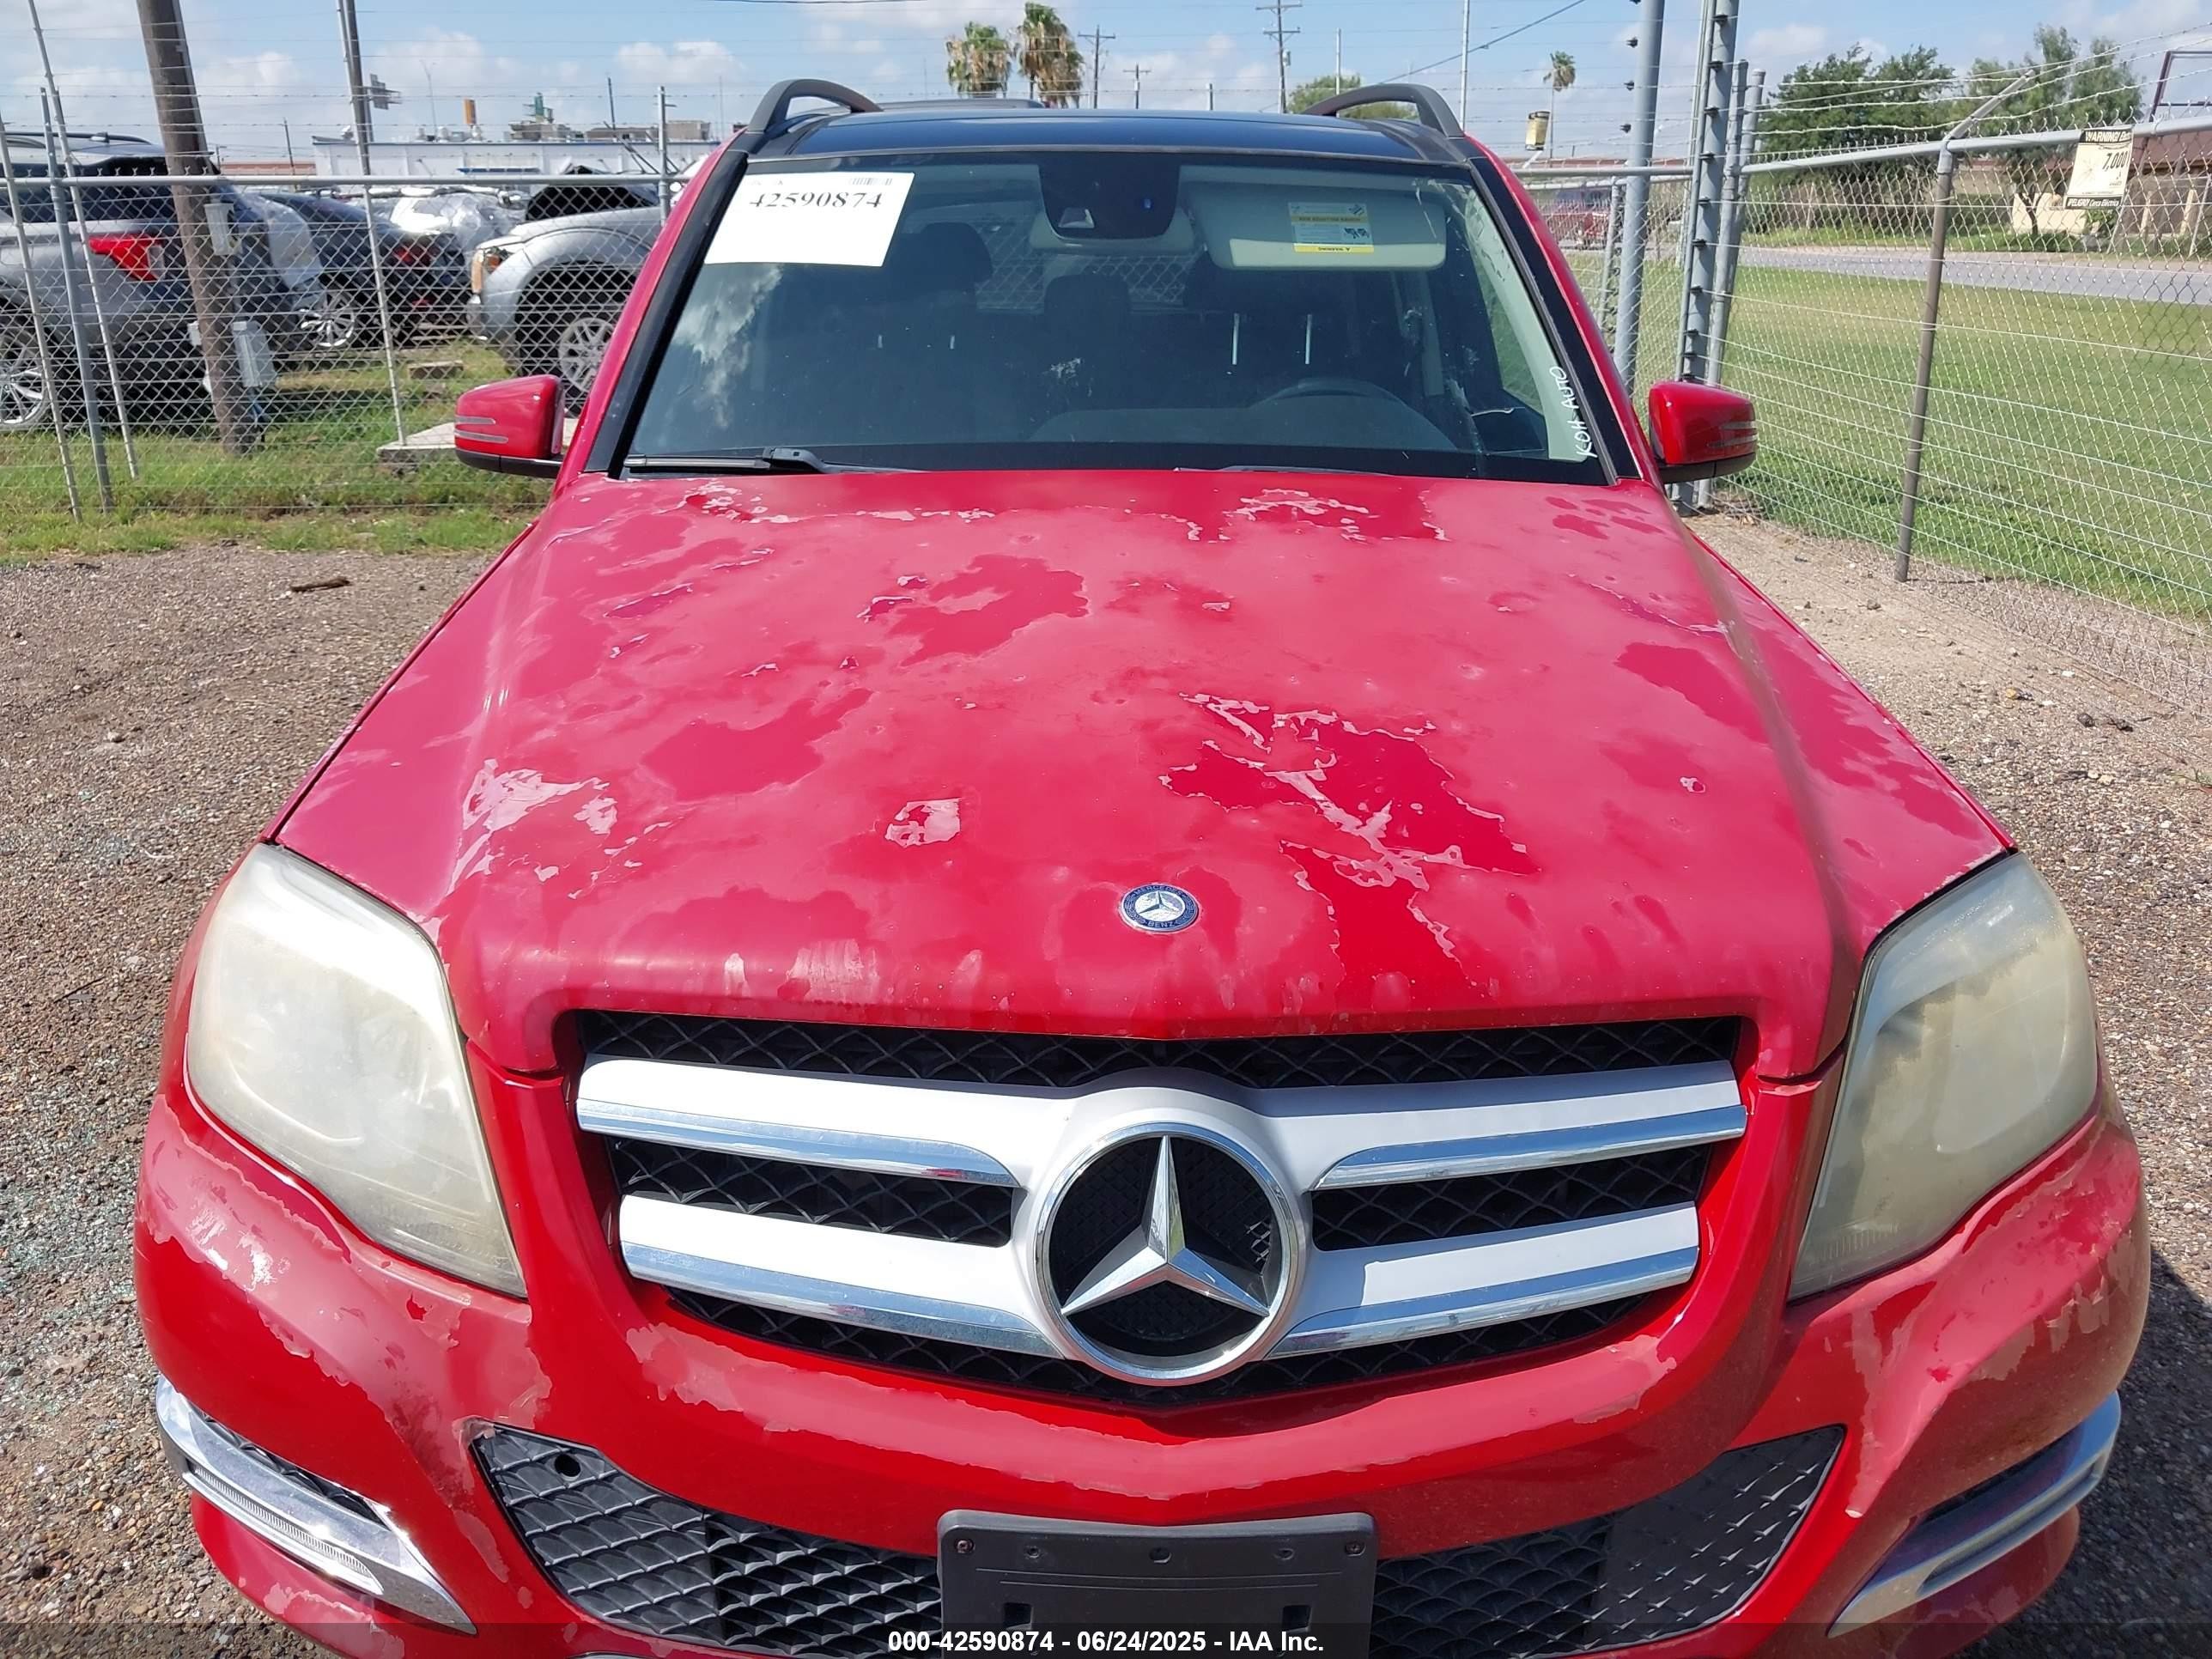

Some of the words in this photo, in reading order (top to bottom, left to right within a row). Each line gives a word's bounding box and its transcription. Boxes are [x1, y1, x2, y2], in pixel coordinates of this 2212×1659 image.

[749, 191, 883, 208] 42590874
[1549, 366, 1579, 410] AUTO
[1567, 420, 1598, 458] KOH
